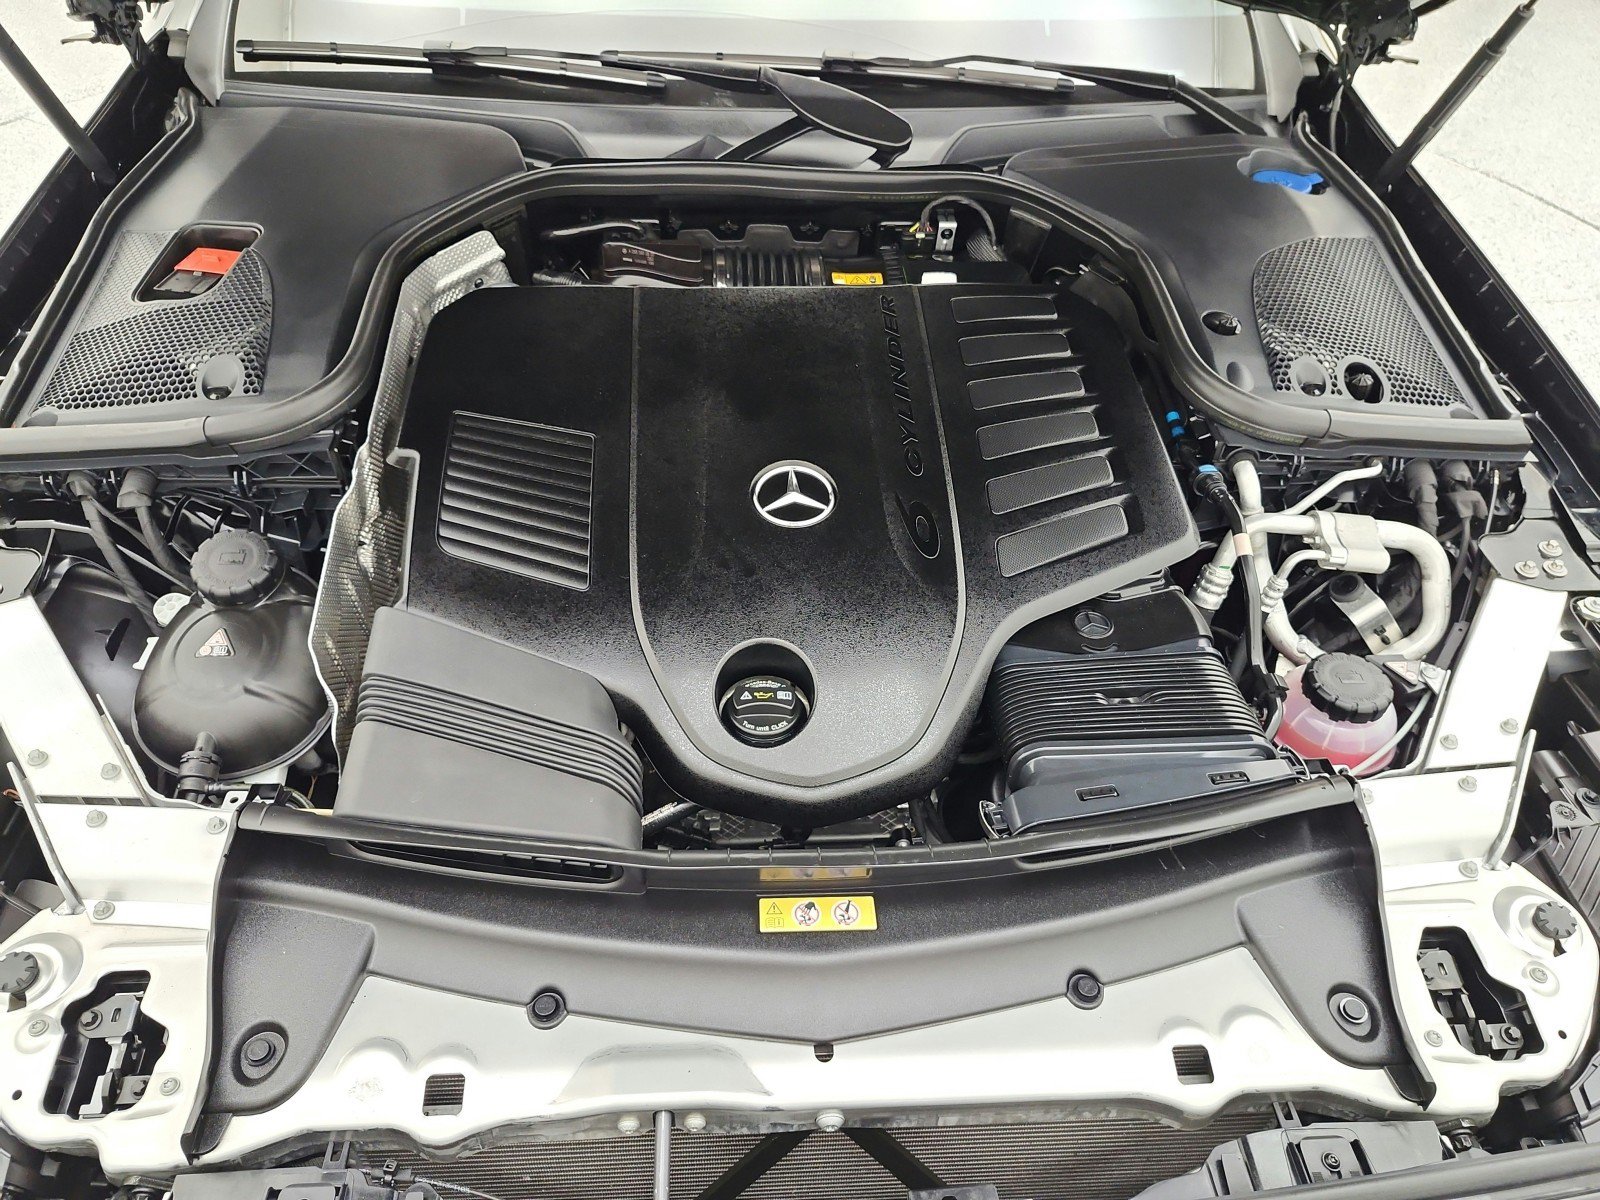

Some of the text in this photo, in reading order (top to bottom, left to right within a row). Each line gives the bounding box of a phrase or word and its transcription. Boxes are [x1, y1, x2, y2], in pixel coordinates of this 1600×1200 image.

[880, 295, 940, 559] 6 CYLINDER
[742, 720, 755, 730] Turn
[771, 720, 789, 731] CLICK
